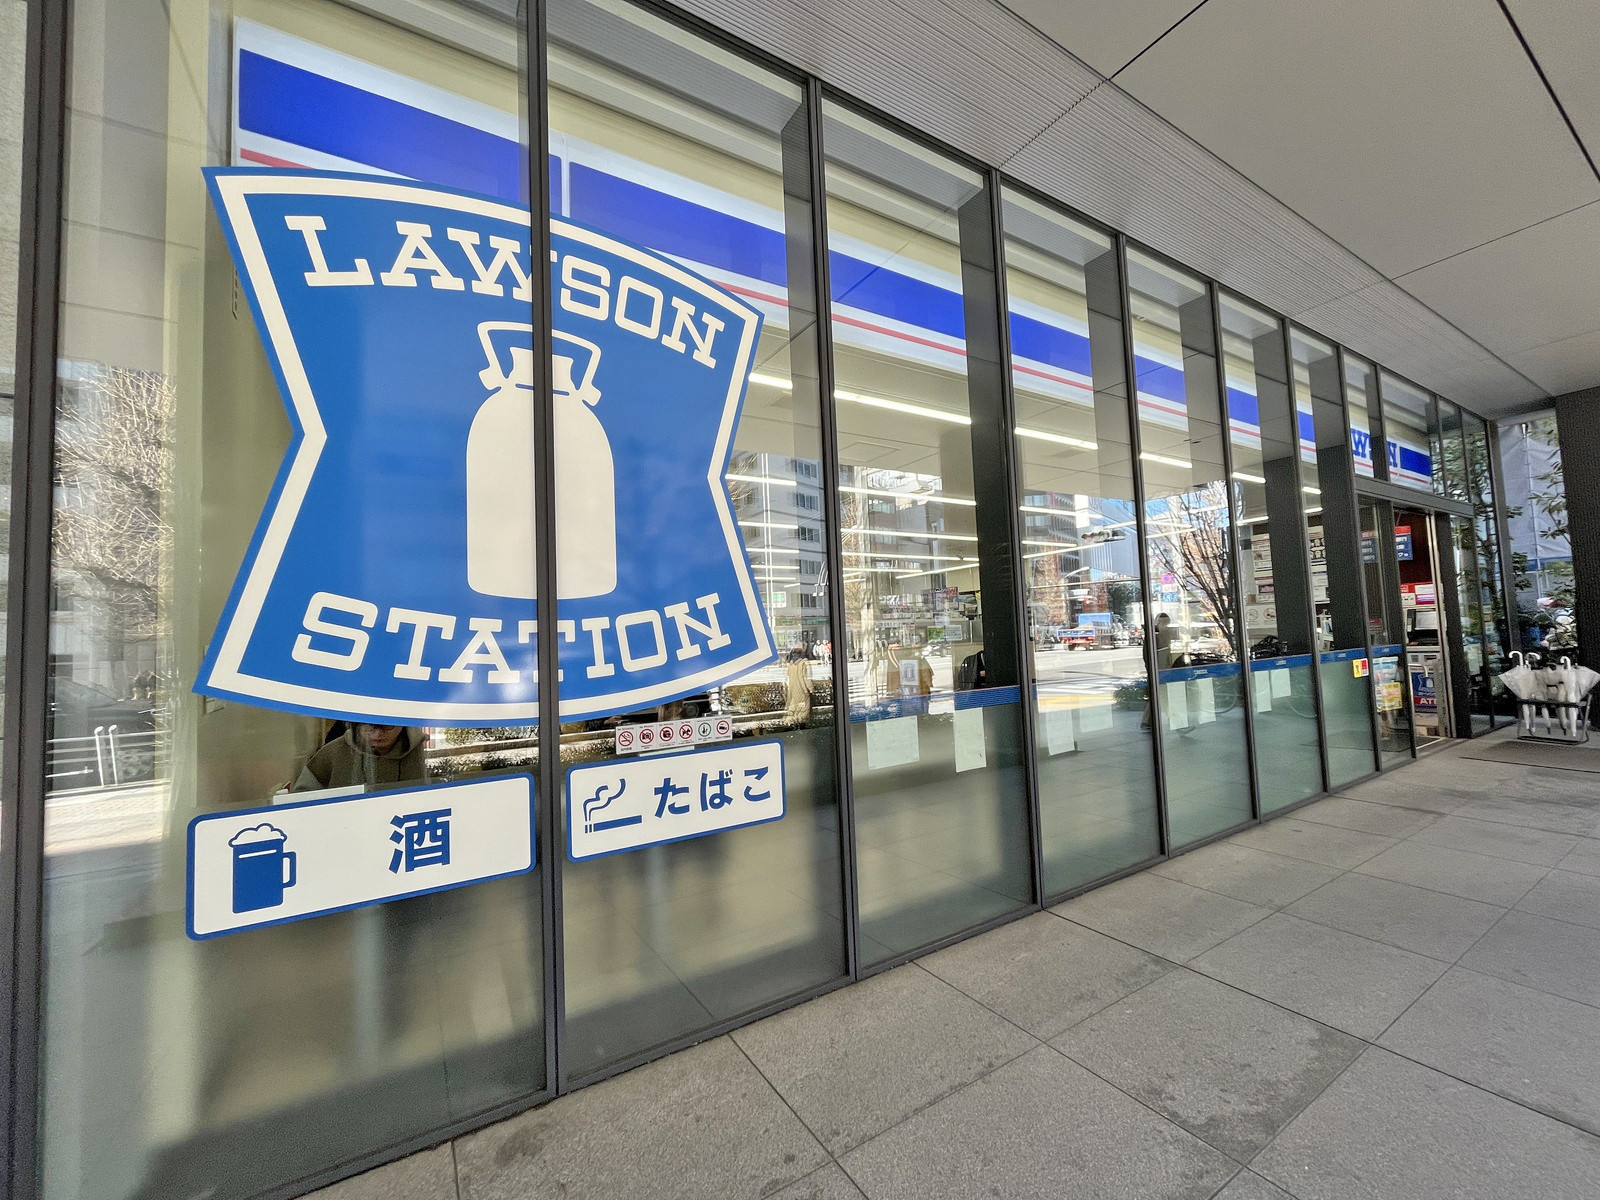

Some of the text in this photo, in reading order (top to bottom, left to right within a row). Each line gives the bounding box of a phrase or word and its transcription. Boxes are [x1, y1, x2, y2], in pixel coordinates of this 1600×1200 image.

[284, 215, 725, 369] LAWSON
[654, 766, 771, 819] たばこ
[388, 808, 452, 874] 酒
